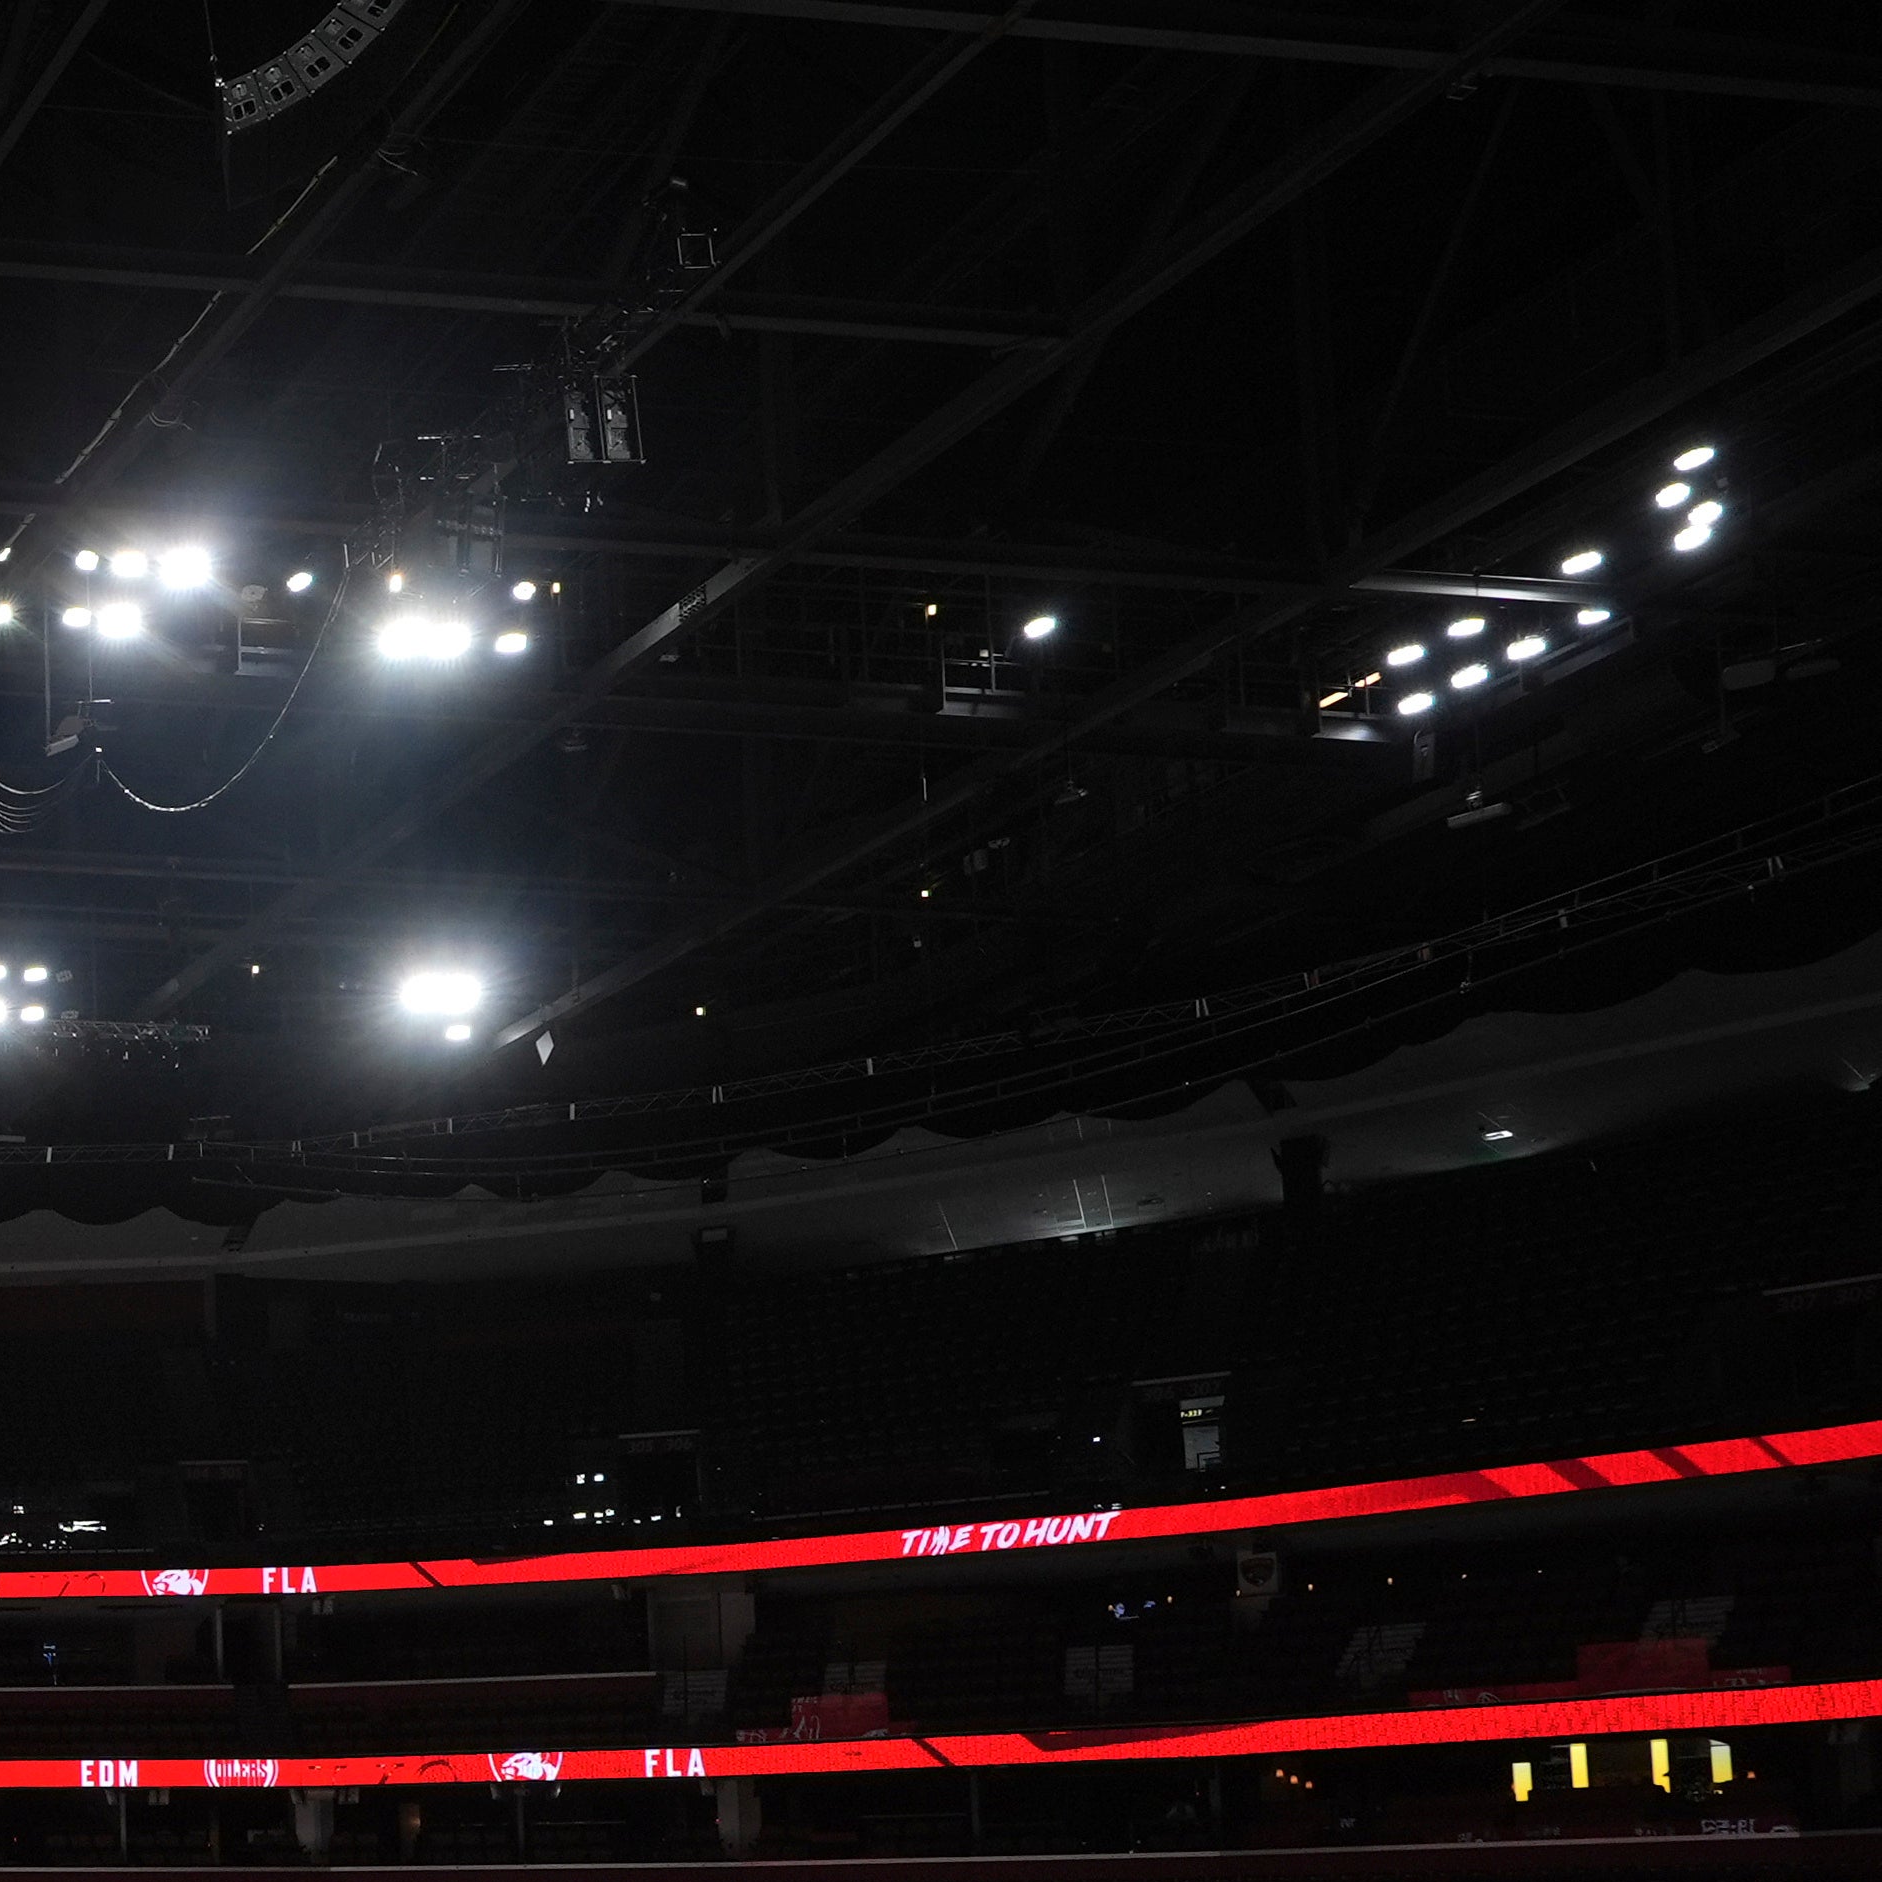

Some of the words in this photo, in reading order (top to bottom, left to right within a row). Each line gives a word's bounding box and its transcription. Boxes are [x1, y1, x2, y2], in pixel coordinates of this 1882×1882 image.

[979, 1521, 1021, 1550] TO
[1021, 1511, 1122, 1544] HUNT
[262, 1565, 317, 1594] FLA
[80, 1759, 139, 1788] EDM
[645, 1748, 706, 1778] FLA
